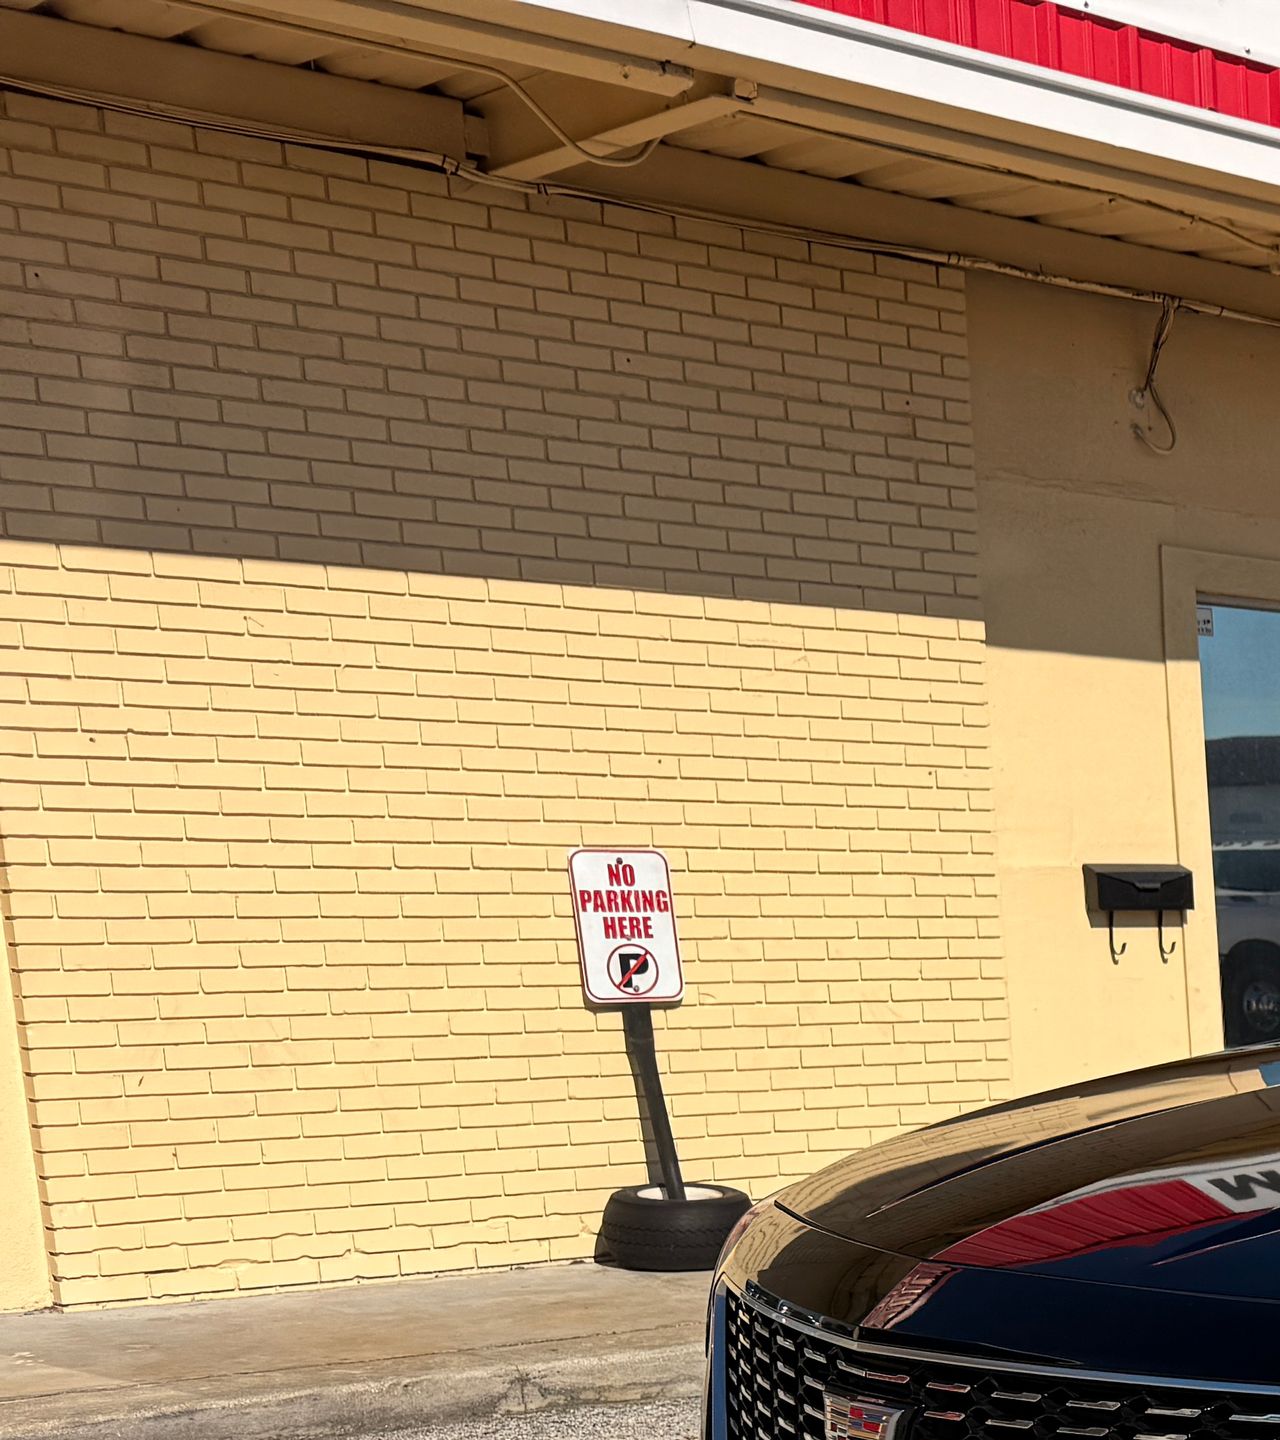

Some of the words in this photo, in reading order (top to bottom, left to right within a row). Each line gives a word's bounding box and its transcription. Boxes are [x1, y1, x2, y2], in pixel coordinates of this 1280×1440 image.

[607, 863, 636, 887] NO
[578, 889, 670, 913] PARKING
[602, 915, 655, 940] HERE
